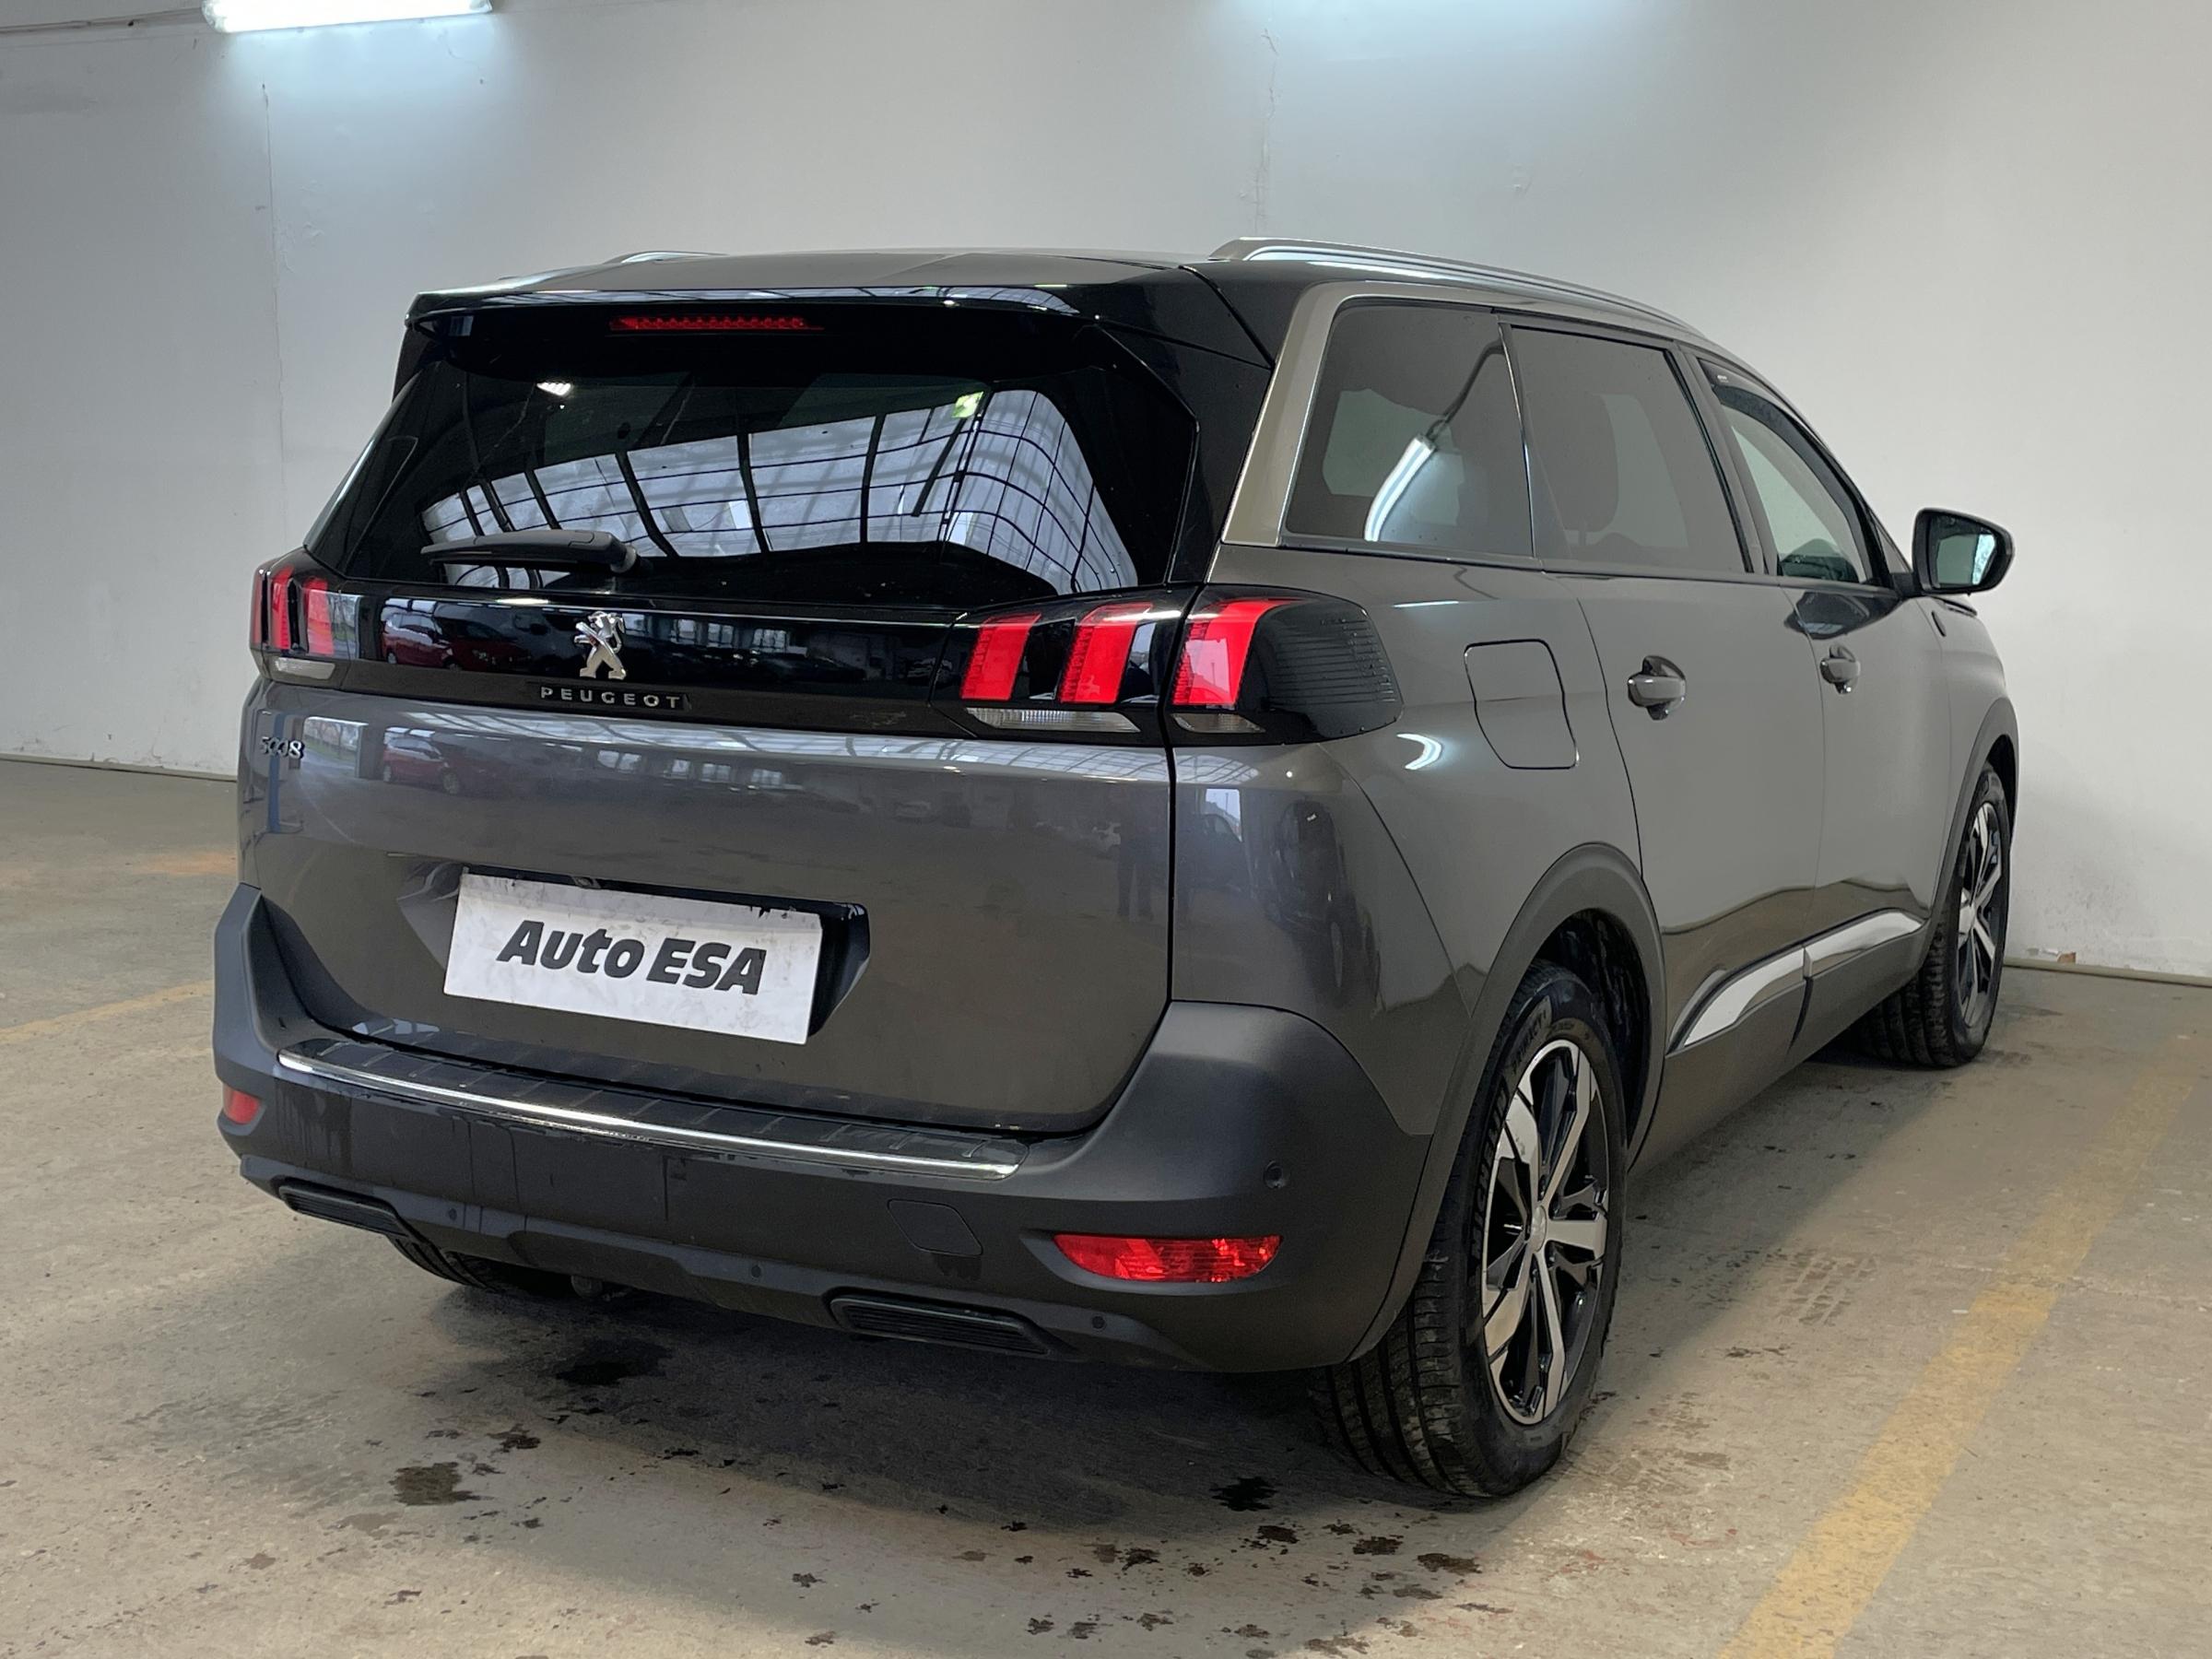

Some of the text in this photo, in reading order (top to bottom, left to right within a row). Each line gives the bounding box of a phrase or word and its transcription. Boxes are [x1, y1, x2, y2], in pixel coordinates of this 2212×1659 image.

[540, 686, 681, 710] PEUGEOT
[495, 919, 768, 995] Auto ESA
